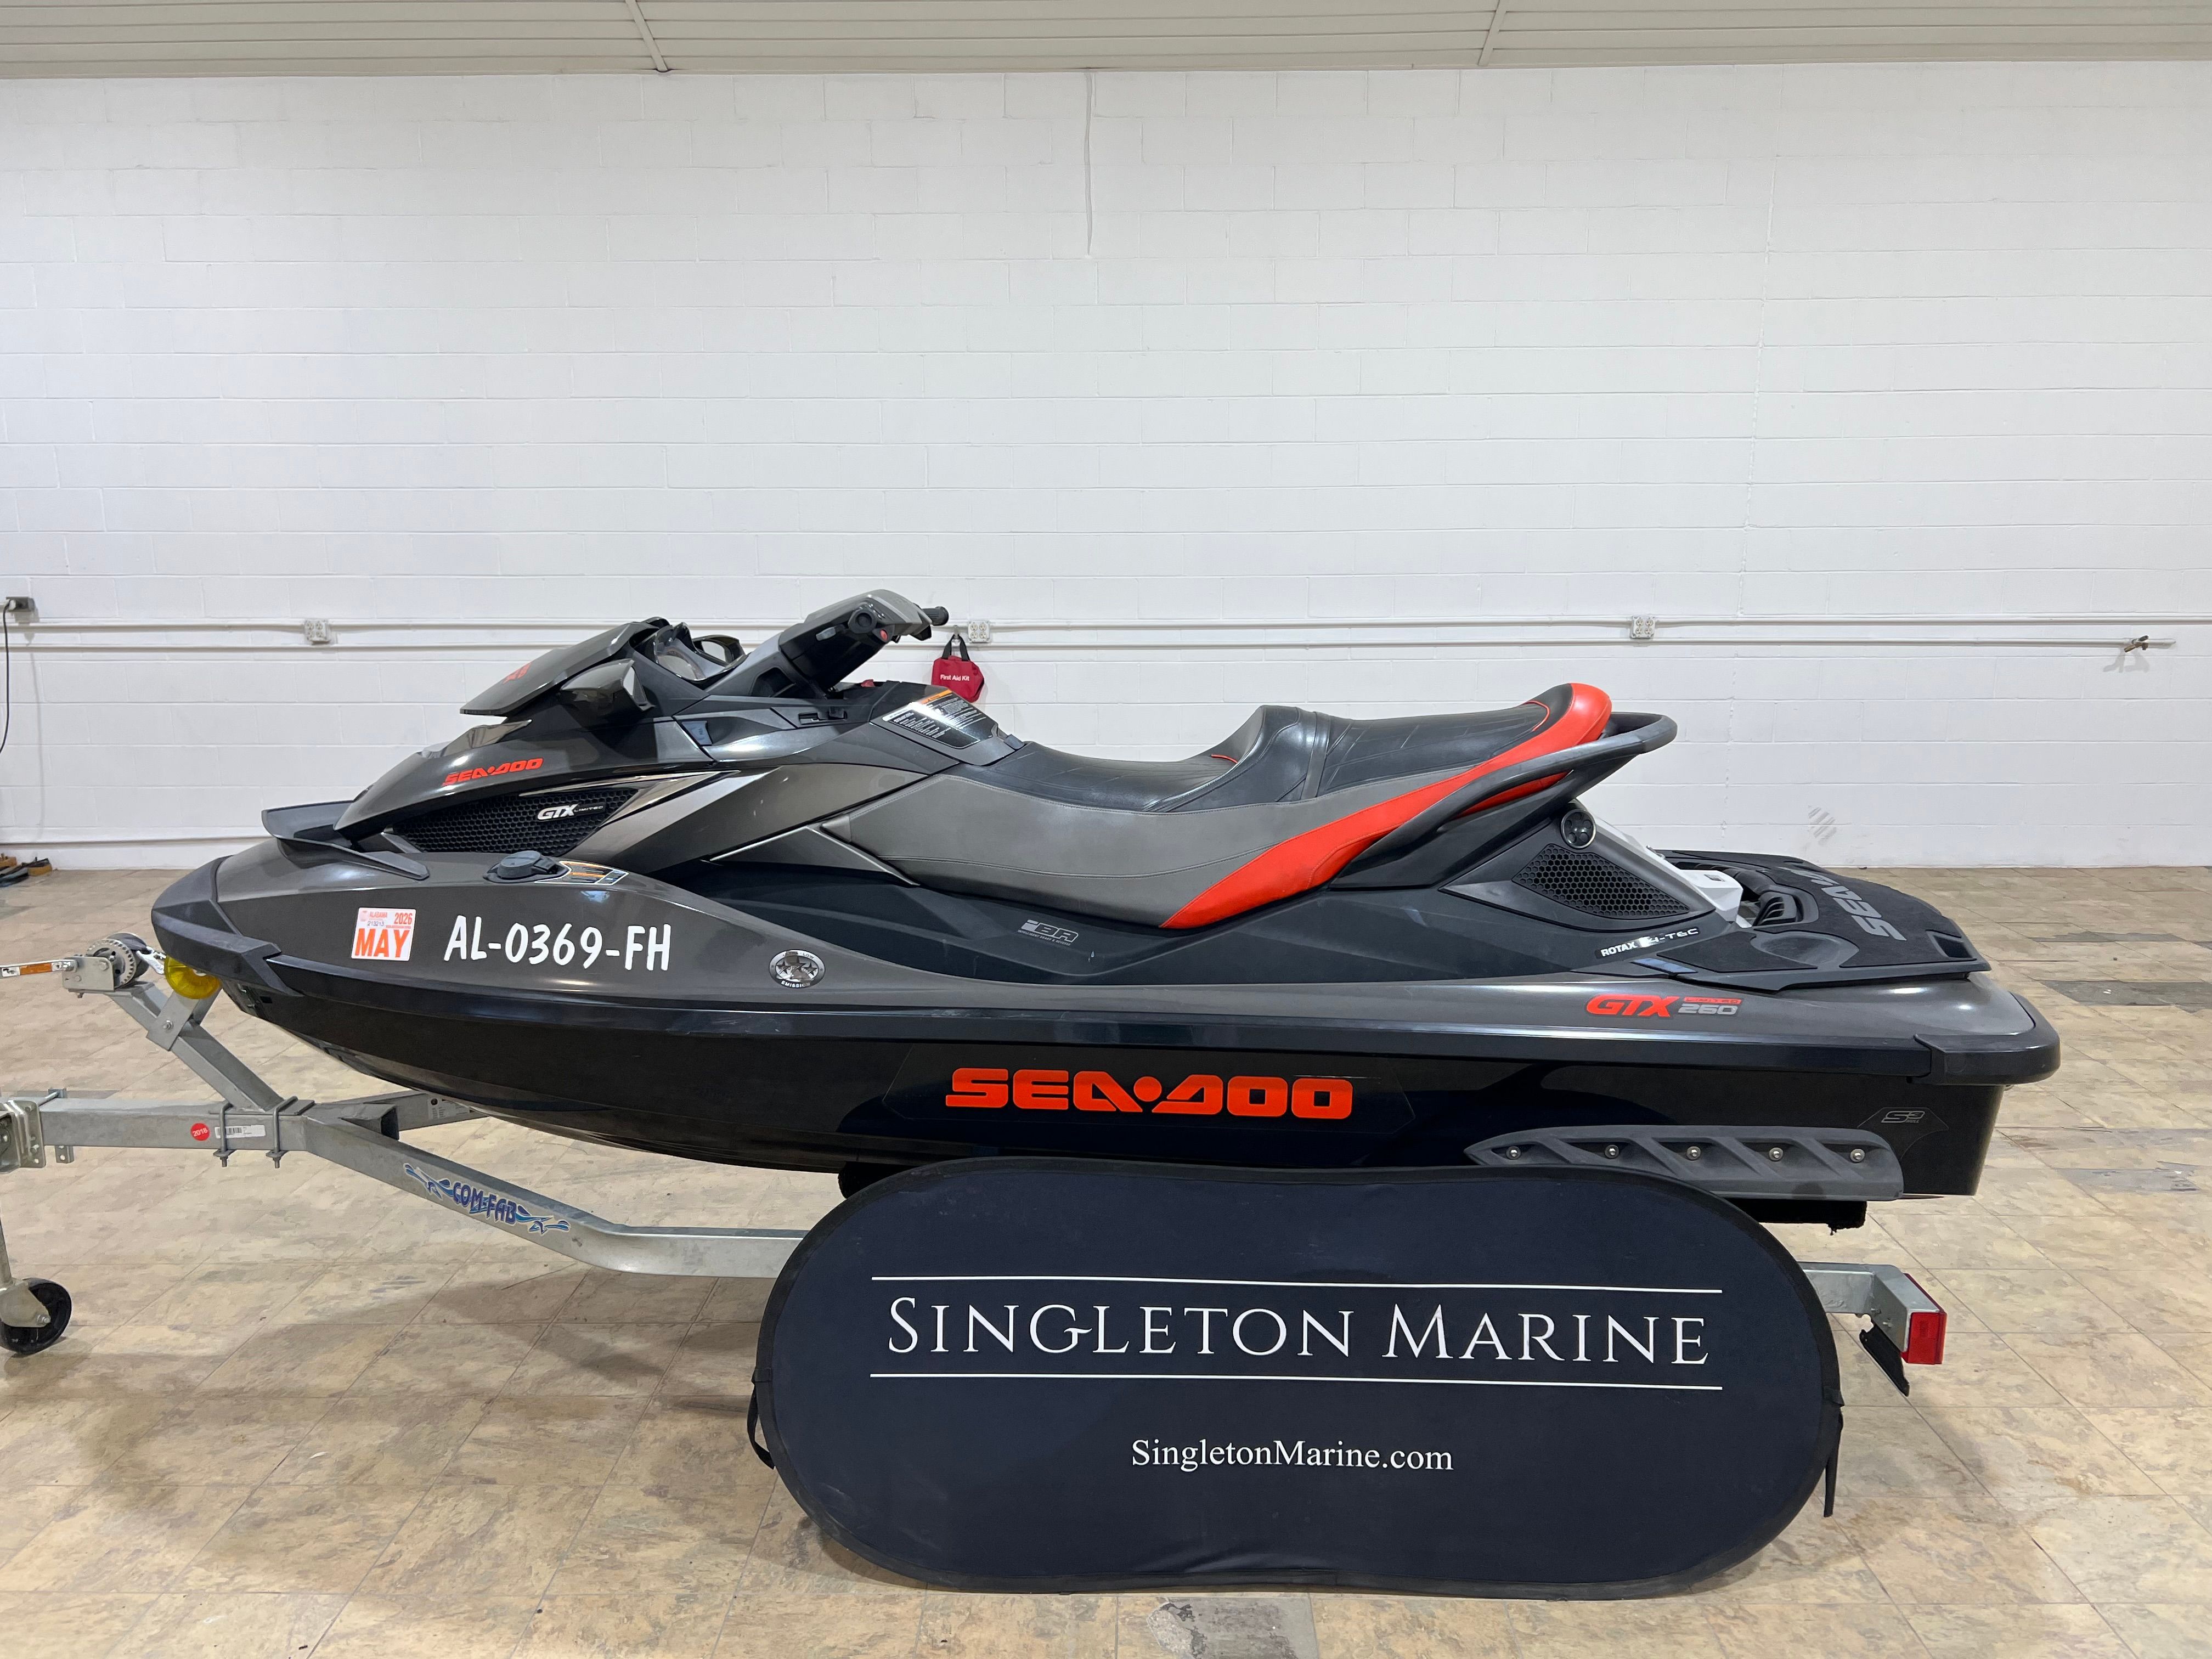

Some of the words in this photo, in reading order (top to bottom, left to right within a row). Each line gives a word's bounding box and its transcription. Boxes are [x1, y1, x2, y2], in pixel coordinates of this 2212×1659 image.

[538, 803, 579, 820] GTX
[394, 912, 413, 925] 2026
[355, 928, 410, 958] MAY
[444, 915, 671, 971] AL-0369-FH
[1600, 941, 1638, 957] ROTAX
[781, 980, 811, 988] EMISSION
[1586, 994, 1680, 1017] GTX
[1678, 1003, 1738, 1015] 260
[1881, 1110, 1925, 1123] S3
[192, 1127, 208, 1137] 2018
[889, 1297, 1354, 1357] SINGLETON
[1381, 1304, 1708, 1364] MARINE
[1132, 1438, 1454, 1472] SingletonMarine.com
